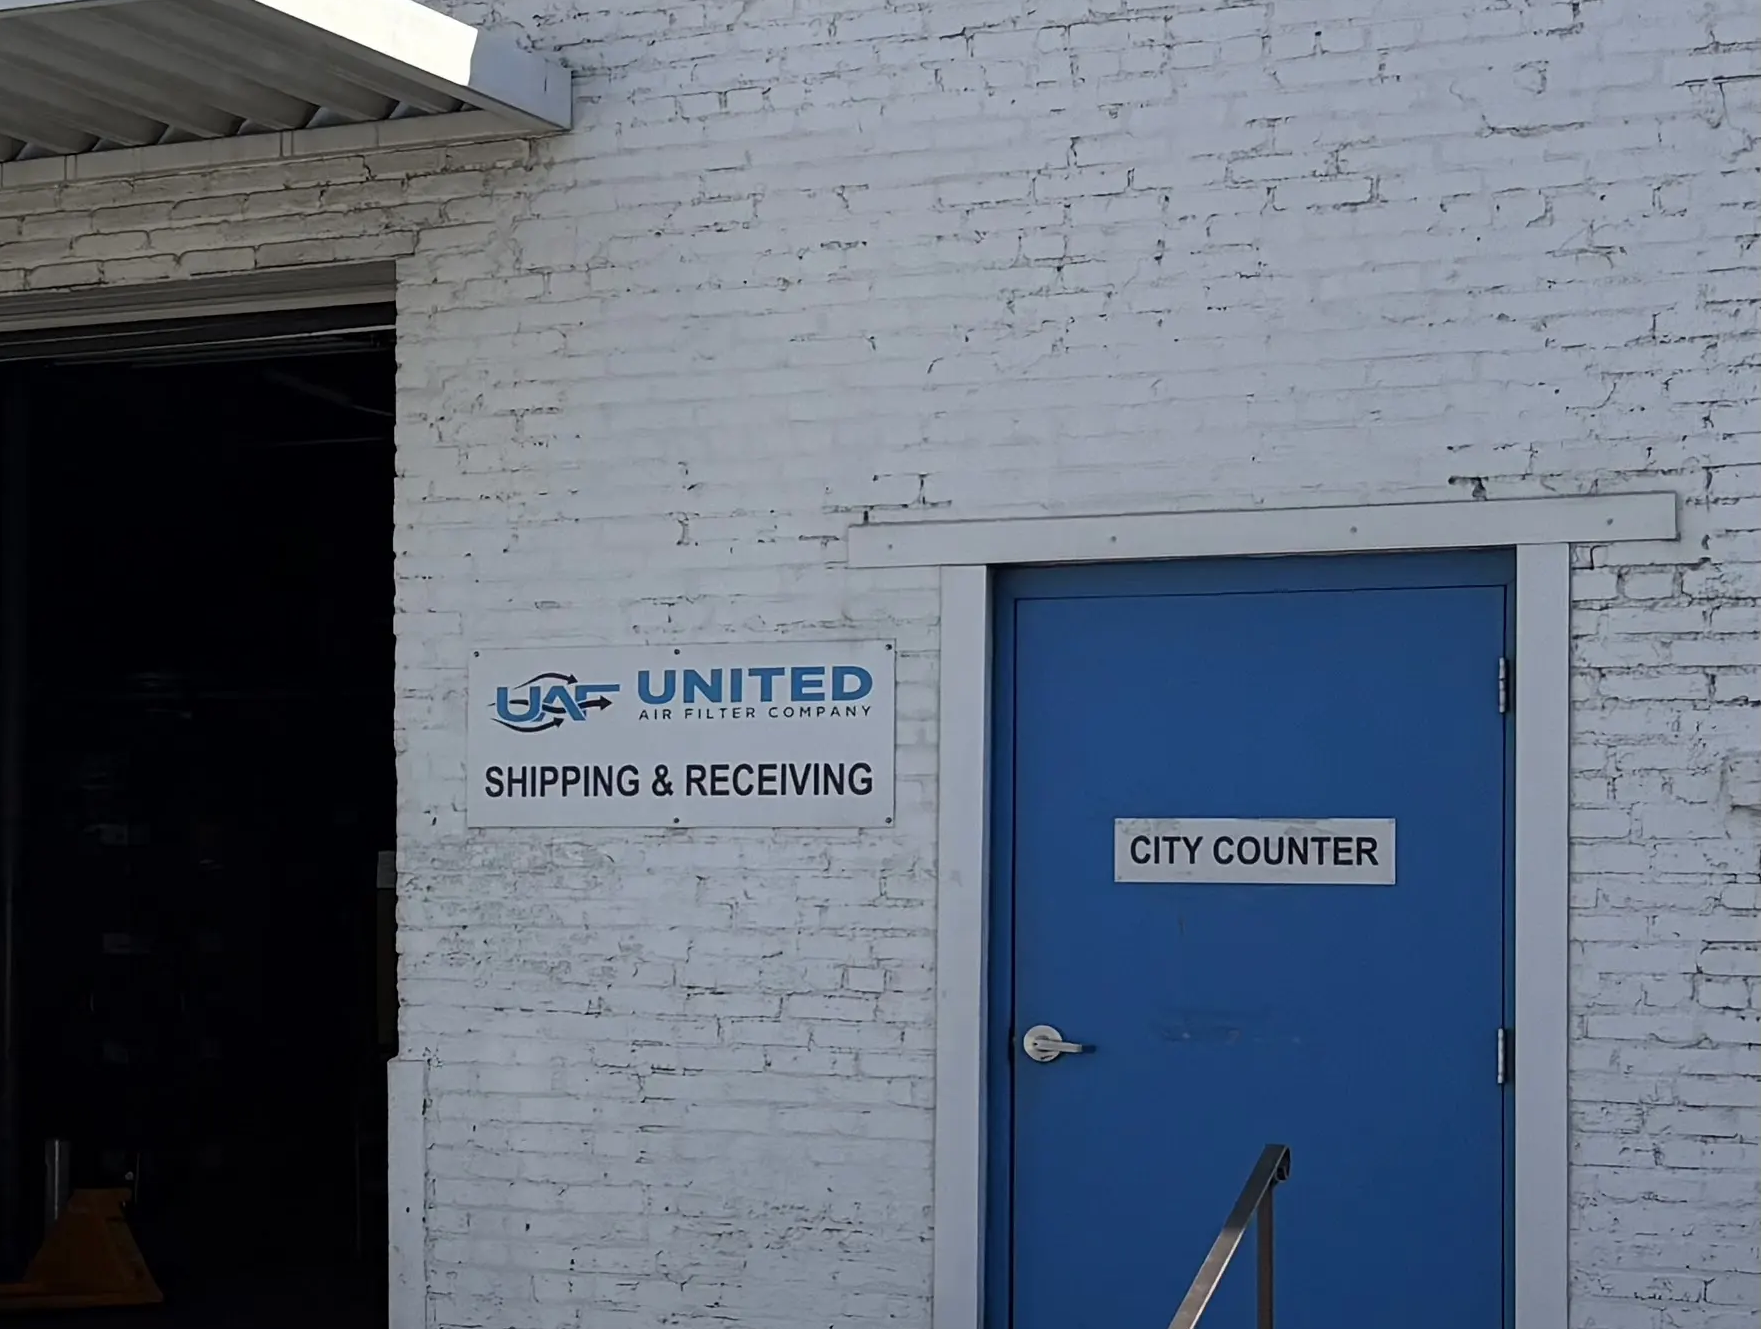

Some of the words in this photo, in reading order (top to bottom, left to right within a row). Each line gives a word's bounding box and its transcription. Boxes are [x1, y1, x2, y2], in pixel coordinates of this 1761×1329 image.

[637, 665, 873, 705] UNITED
[639, 707, 673, 721] AIR
[684, 706, 756, 720] FILTER
[768, 705, 872, 719] COMPANY
[484, 764, 640, 798] SHIPPING
[651, 763, 674, 797] &
[685, 762, 873, 797] RECEIVING
[1130, 835, 1203, 865] CITY
[1213, 835, 1379, 866] COUNTER
